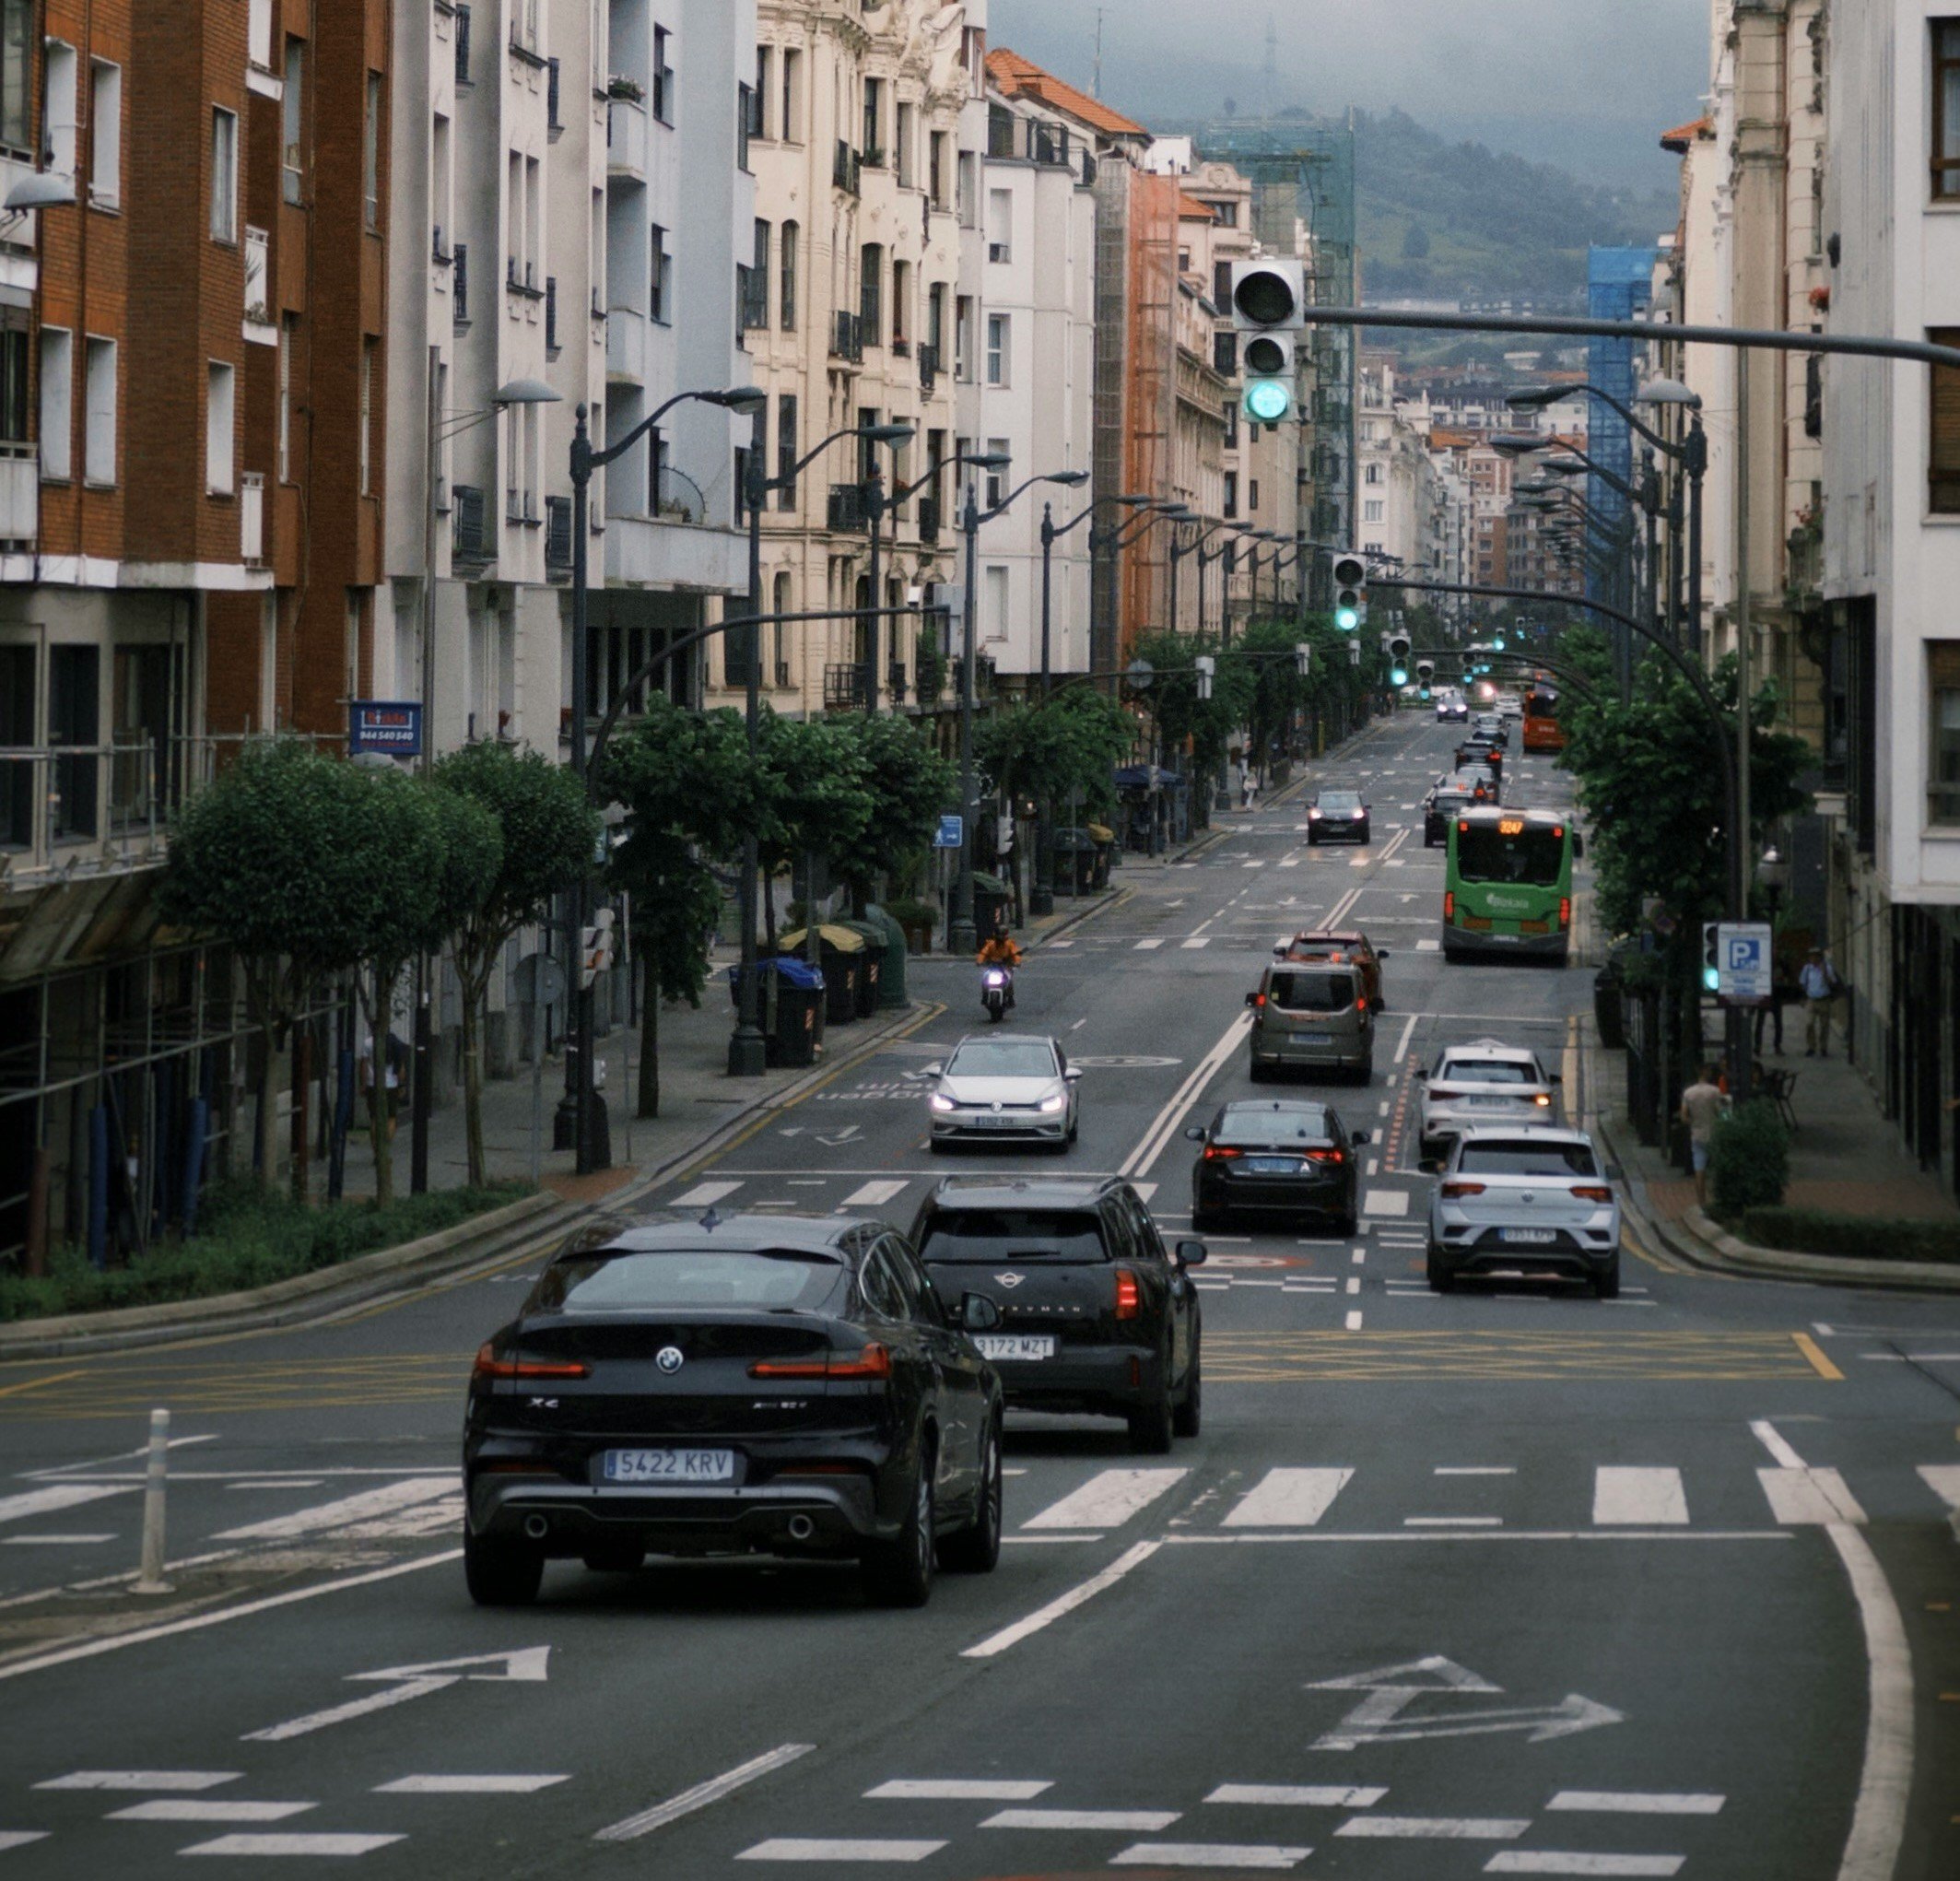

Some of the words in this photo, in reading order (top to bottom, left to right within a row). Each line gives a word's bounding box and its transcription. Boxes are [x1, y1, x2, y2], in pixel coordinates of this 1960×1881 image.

[359, 731, 377, 740] 944
[378, 732, 395, 740] 540
[1498, 820, 1524, 835] 3247
[978, 1338, 1016, 1354] 3172
[1021, 1338, 1050, 1355] MZT
[621, 1452, 677, 1475] 5422
[685, 1452, 728, 1475] KRV
